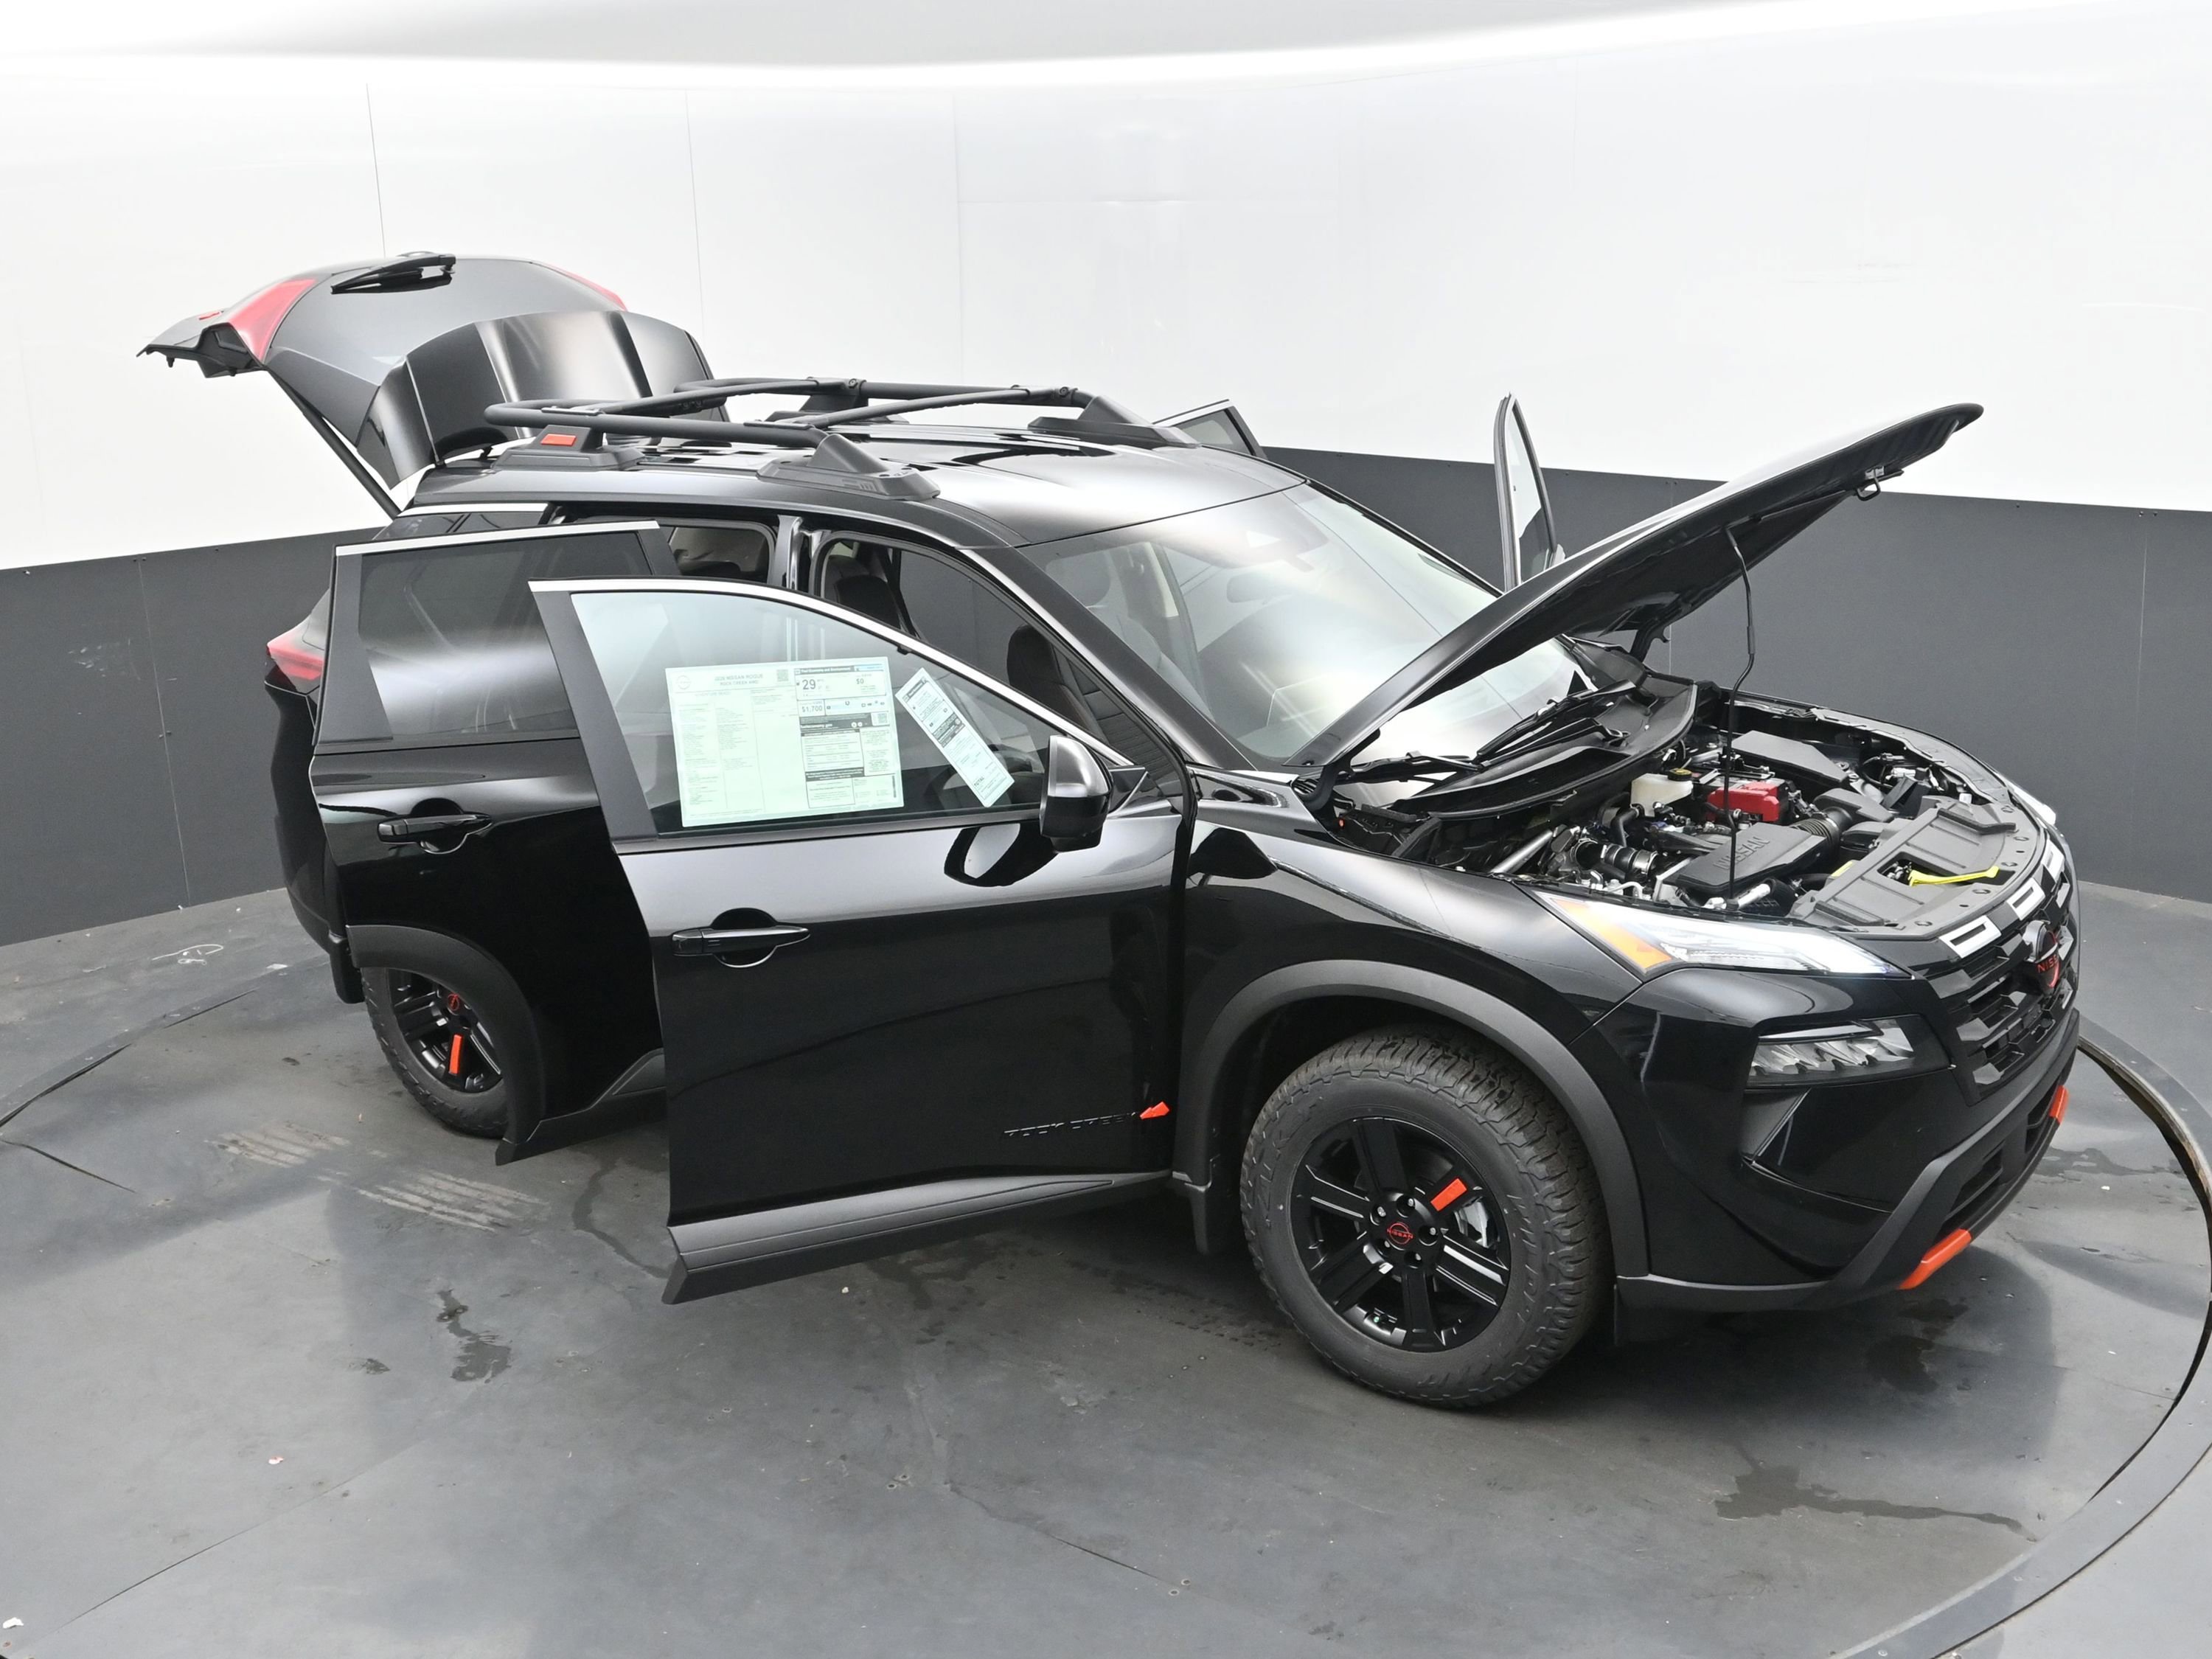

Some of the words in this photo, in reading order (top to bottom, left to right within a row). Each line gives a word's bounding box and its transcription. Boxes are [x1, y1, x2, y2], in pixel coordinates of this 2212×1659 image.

[801, 678, 816, 690] 29
[801, 705, 823, 713] $1,700
[1713, 836, 1771, 872] NISSAN
[2037, 953, 2058, 974] NISS
[1387, 1228, 1413, 1239] NISSAN
